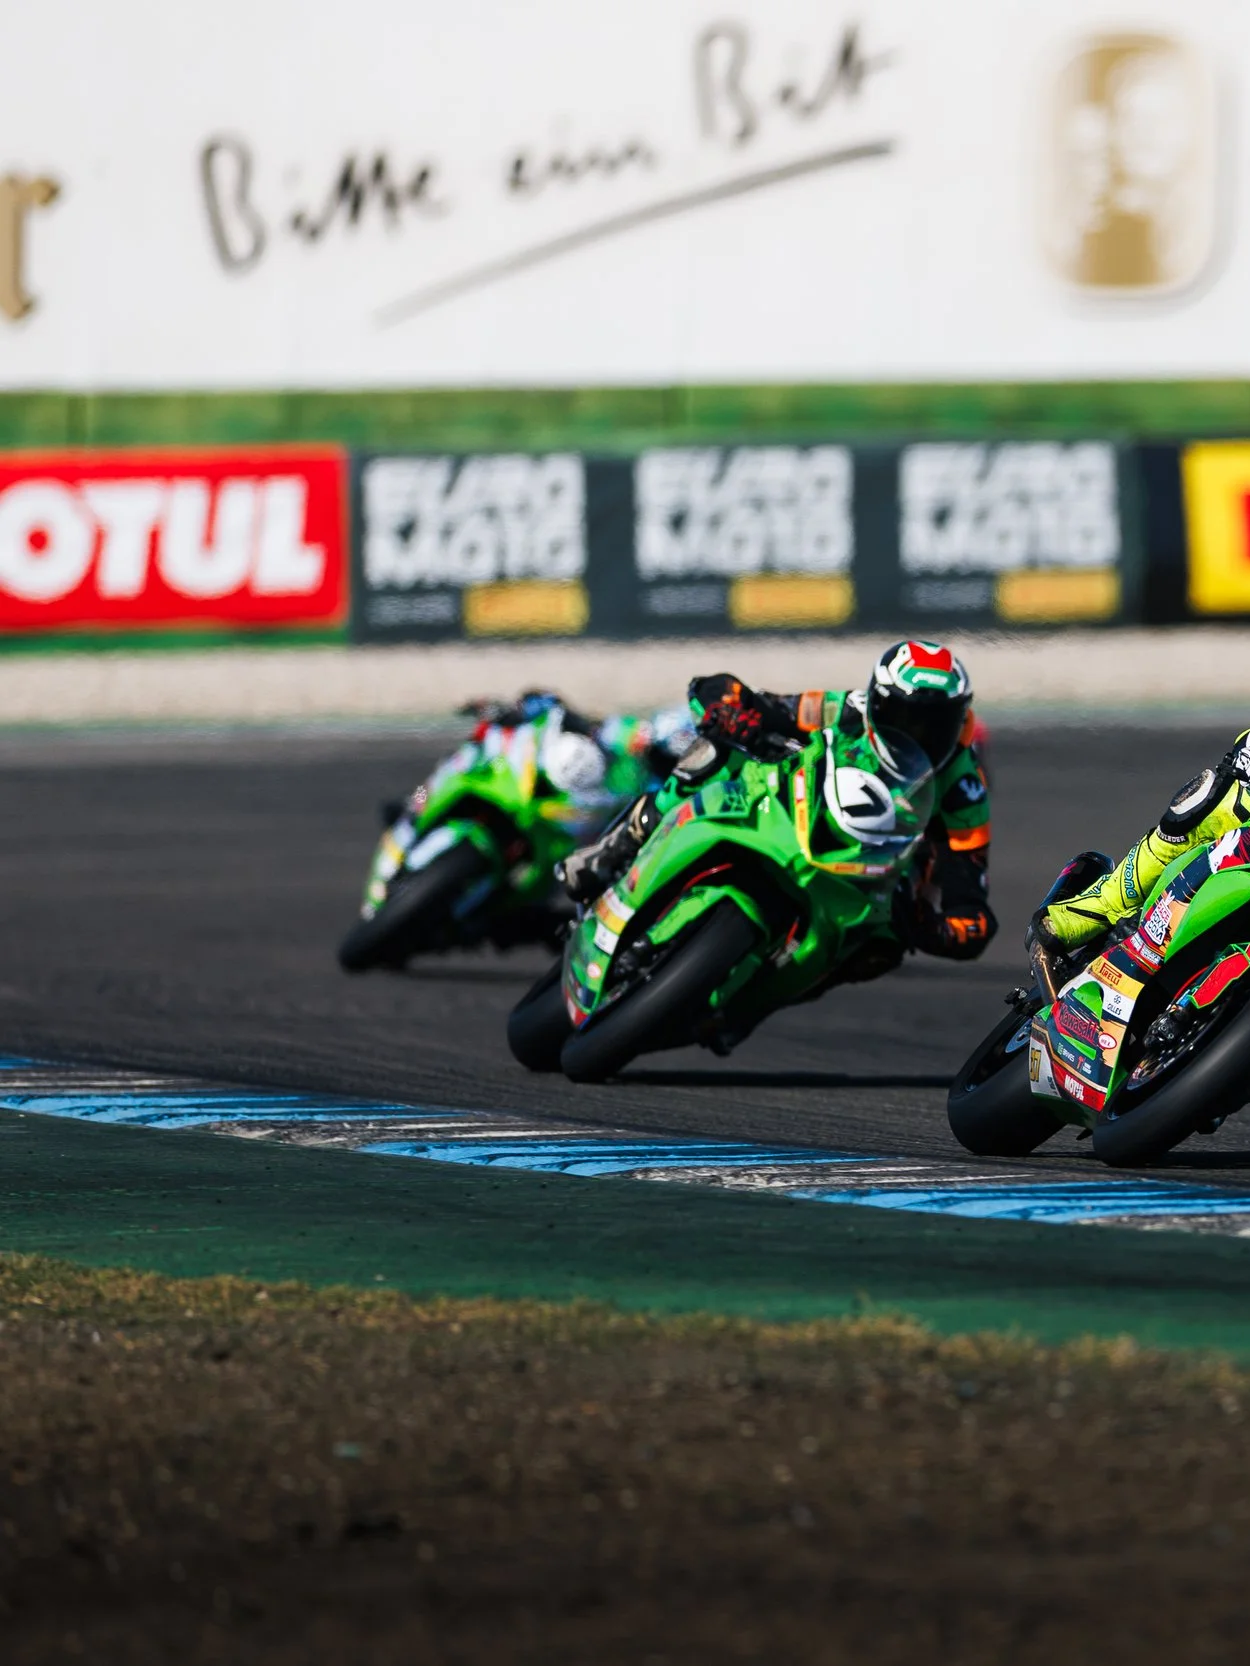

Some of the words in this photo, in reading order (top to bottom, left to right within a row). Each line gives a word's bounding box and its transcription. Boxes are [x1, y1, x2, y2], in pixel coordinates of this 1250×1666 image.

[1100, 962, 1123, 986] PIRELLI
[1106, 1003, 1122, 1016] GILLES
[1060, 1003, 1098, 1045] Kawasaki
[1064, 1074, 1084, 1101] MOTUL
